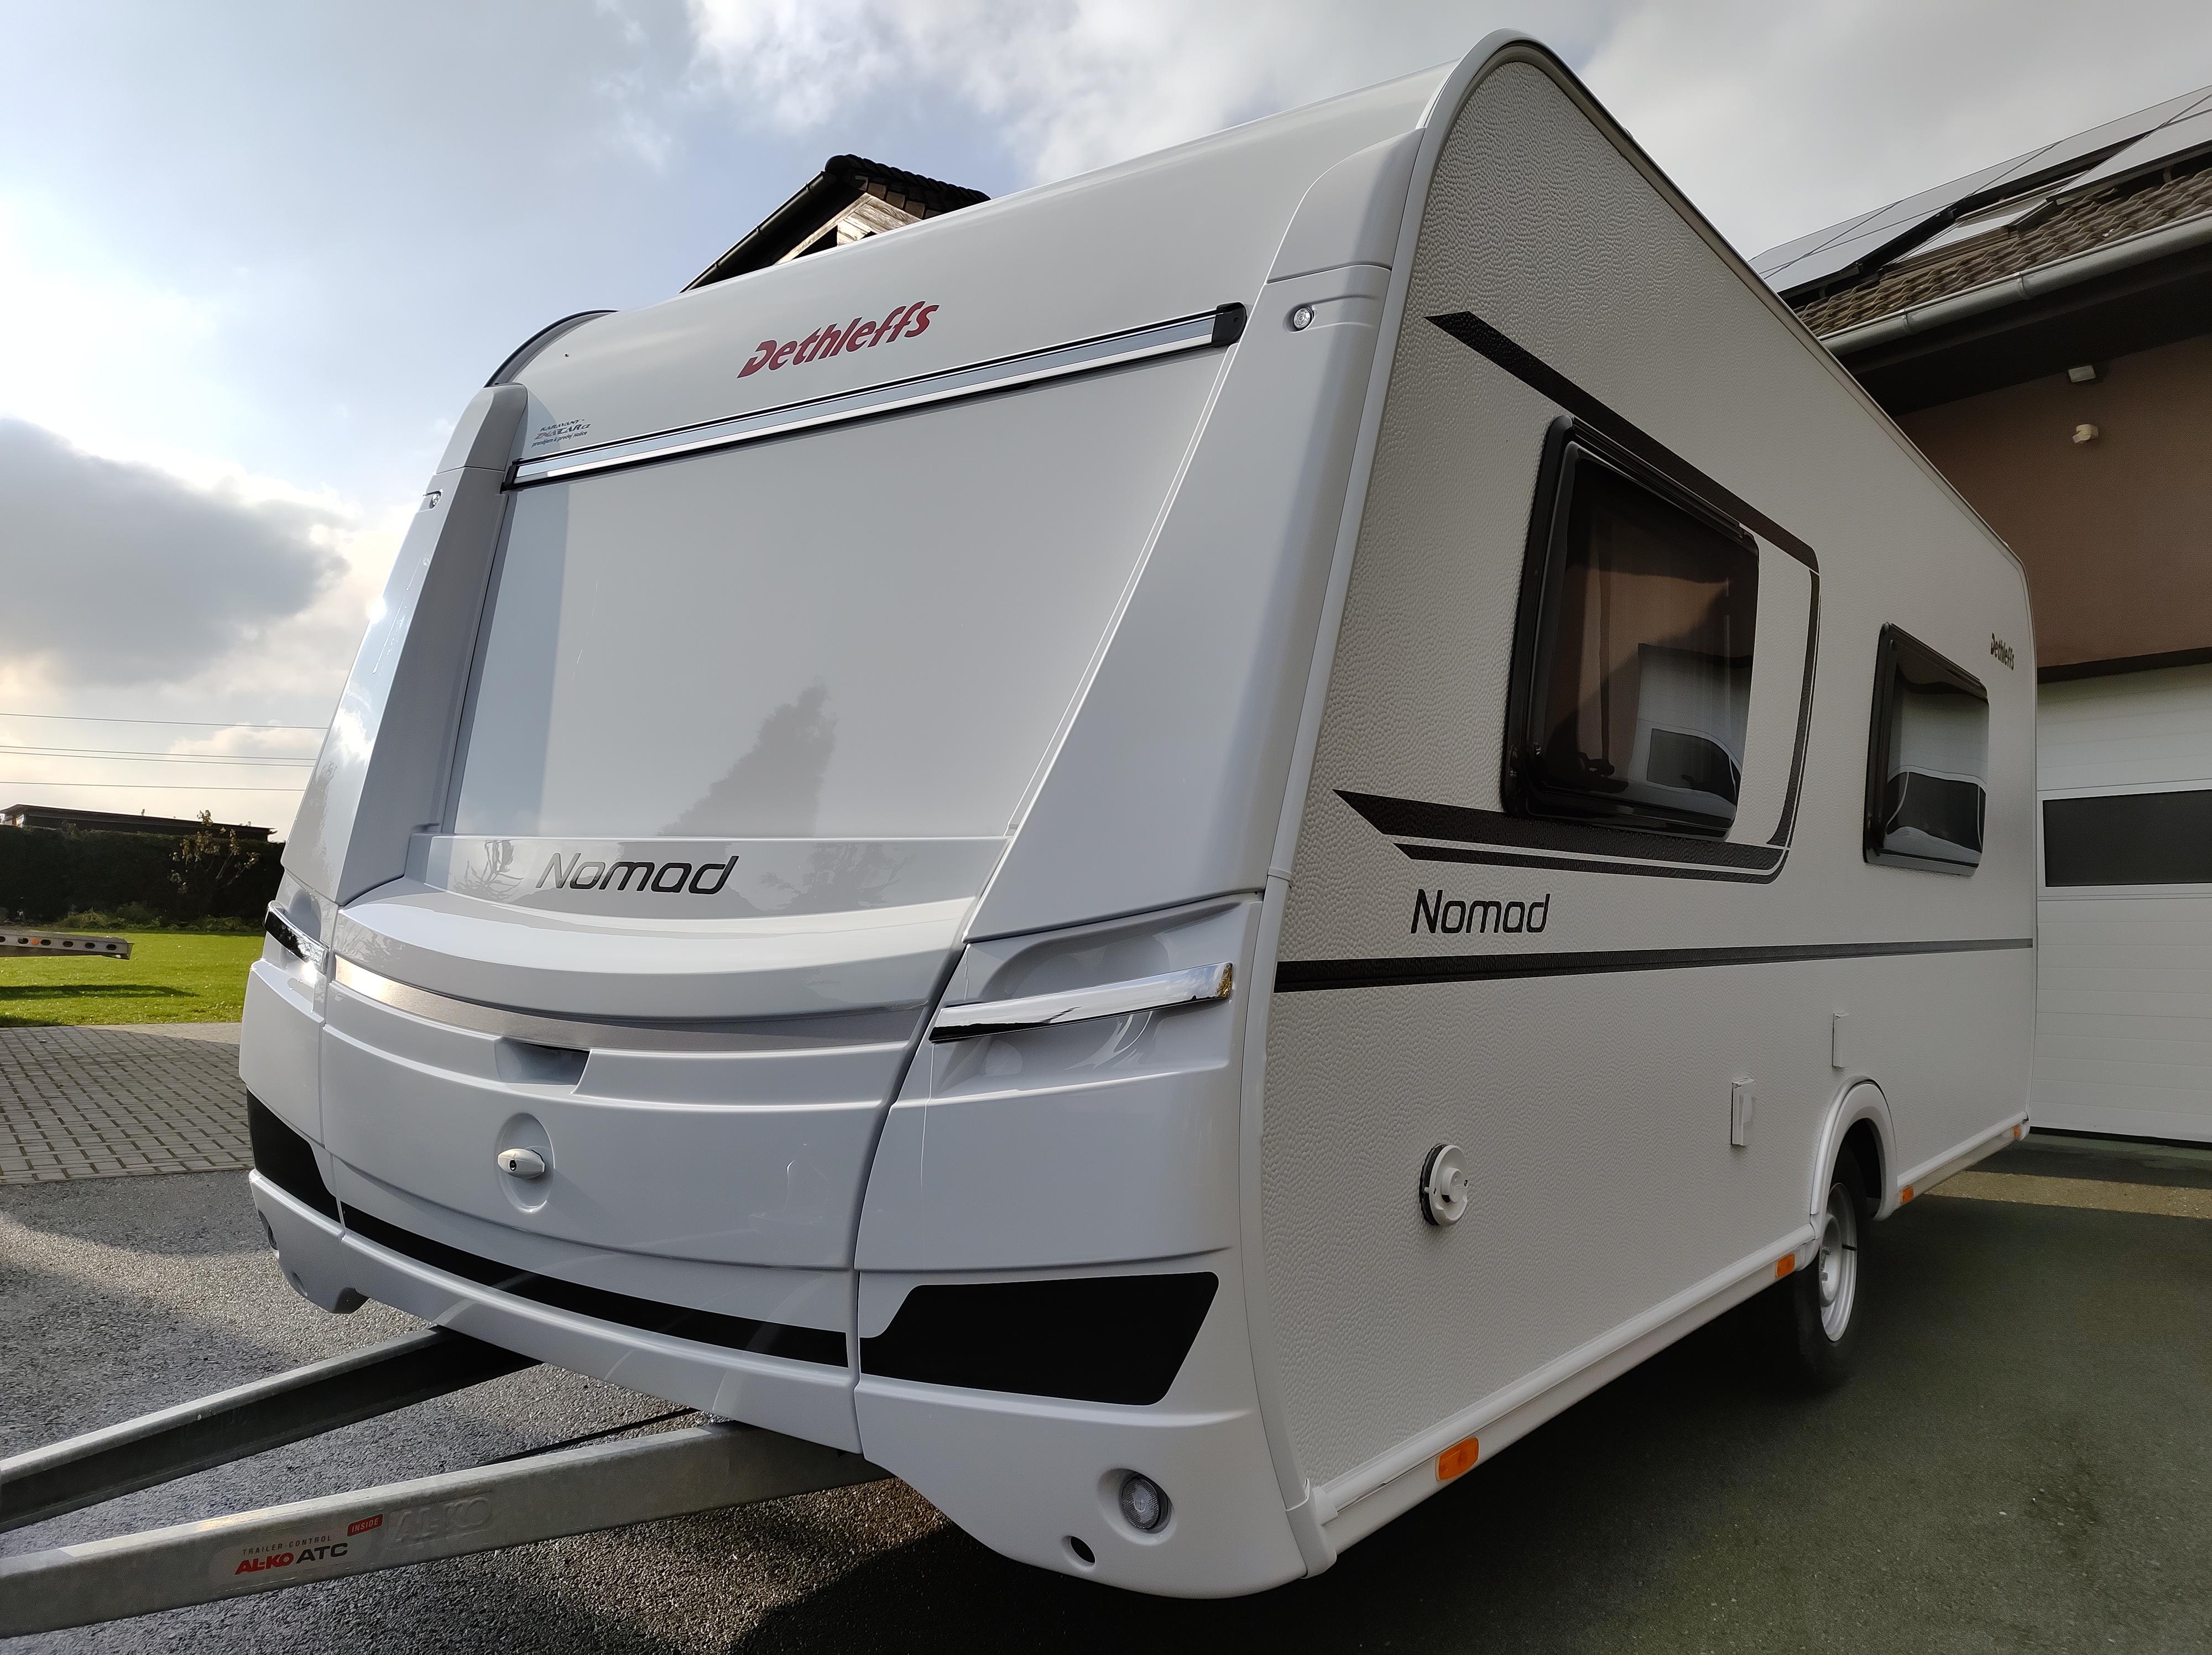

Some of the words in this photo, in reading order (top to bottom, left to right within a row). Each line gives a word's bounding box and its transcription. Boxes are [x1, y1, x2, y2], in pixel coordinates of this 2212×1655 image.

[737, 300, 940, 379] Dethleffs
[1990, 632, 2015, 671] Dethleffs
[535, 852, 739, 895] Nomad
[1410, 889, 1551, 934] Nomad
[352, 1517, 379, 1533] INSIDE
[234, 1552, 294, 1575] AL-KO
[295, 1543, 348, 1564] ATC
